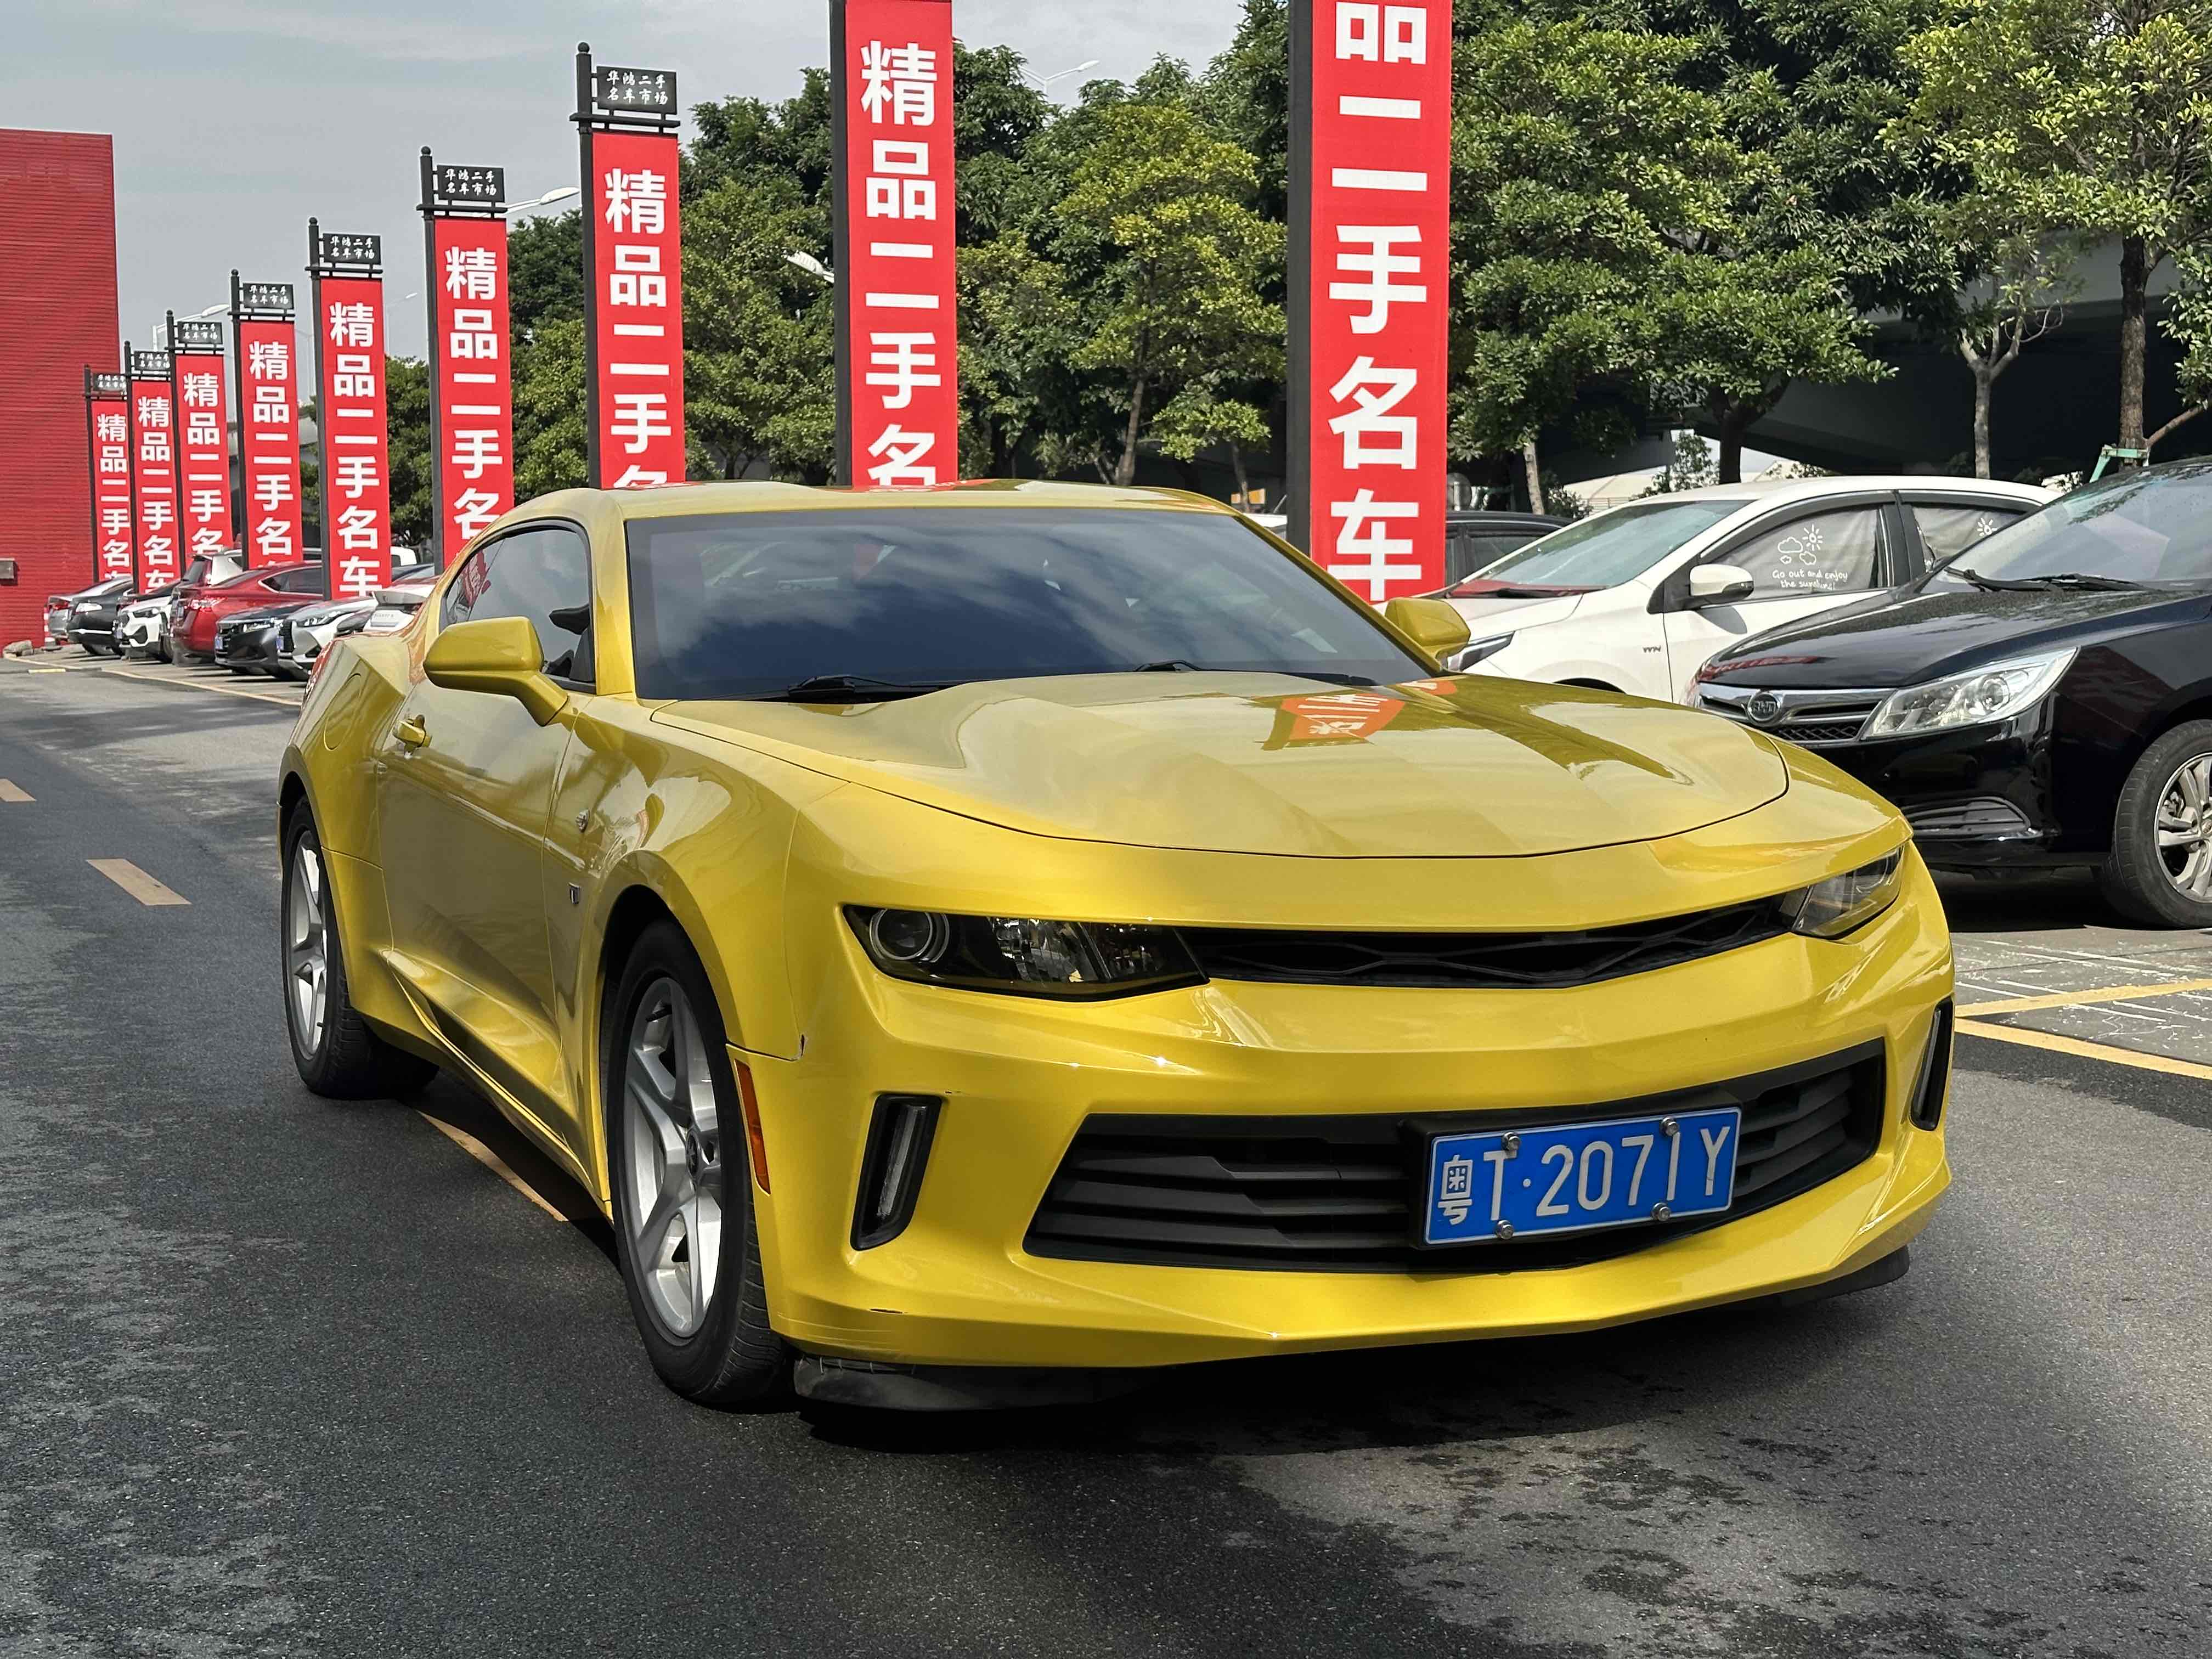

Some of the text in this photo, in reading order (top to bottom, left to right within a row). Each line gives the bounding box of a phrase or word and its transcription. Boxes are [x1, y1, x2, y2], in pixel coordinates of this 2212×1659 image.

[606, 70, 665, 89] 华鸿二手
[607, 87, 668, 105] 名车市场
[249, 340, 294, 567] 精品二手名
[329, 301, 382, 596] 精品二手名车
[1772, 569, 1848, 583] Go out and enjoy
[1780, 579, 1797, 588] the
